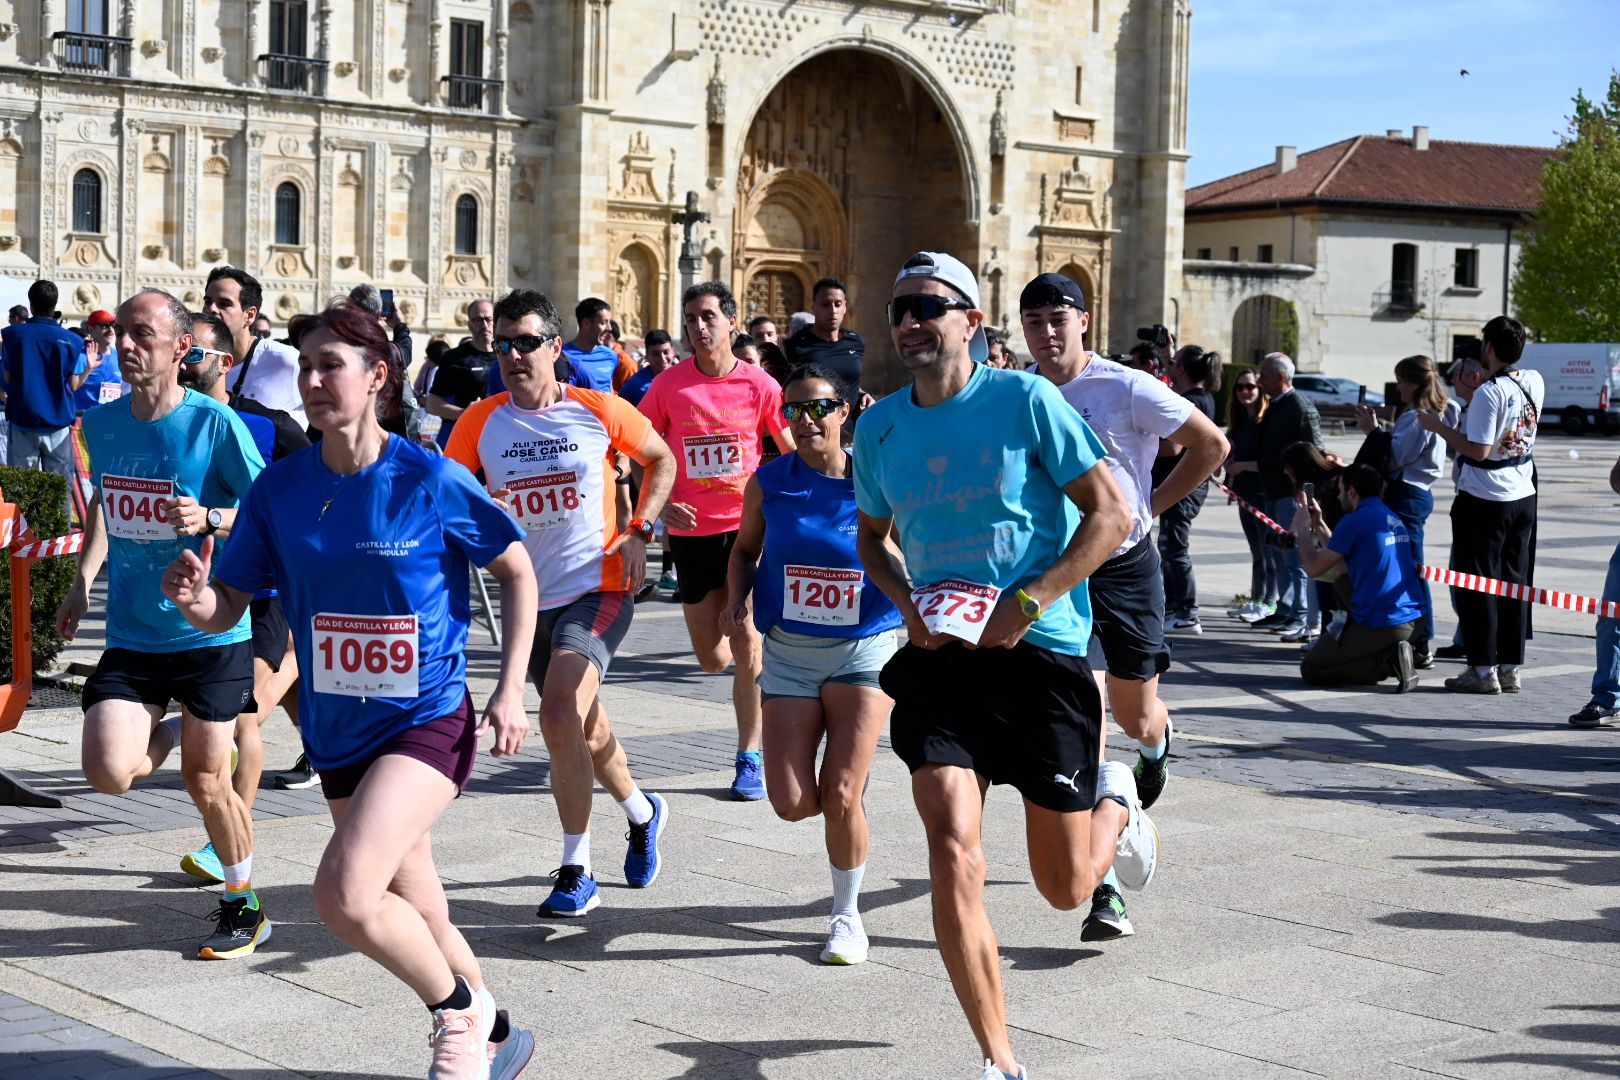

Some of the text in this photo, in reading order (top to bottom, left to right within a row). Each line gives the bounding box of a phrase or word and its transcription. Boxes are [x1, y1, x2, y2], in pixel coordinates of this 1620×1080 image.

[532, 437, 567, 447] TROPEO
[501, 444, 578, 458] JOSÉ CANO
[688, 446, 739, 466] 1112
[520, 454, 559, 463] CANILLEJAS
[122, 480, 147, 489] CASTILLA
[511, 487, 579, 518] 1018
[402, 539, 419, 548] LEÓN
[790, 580, 855, 609] 1201
[317, 618, 331, 627] DÍA
[332, 620, 342, 628] DE
[344, 621, 381, 630] CASTILLA
[390, 620, 412, 630] LEÓN
[319, 636, 414, 674] 1069
